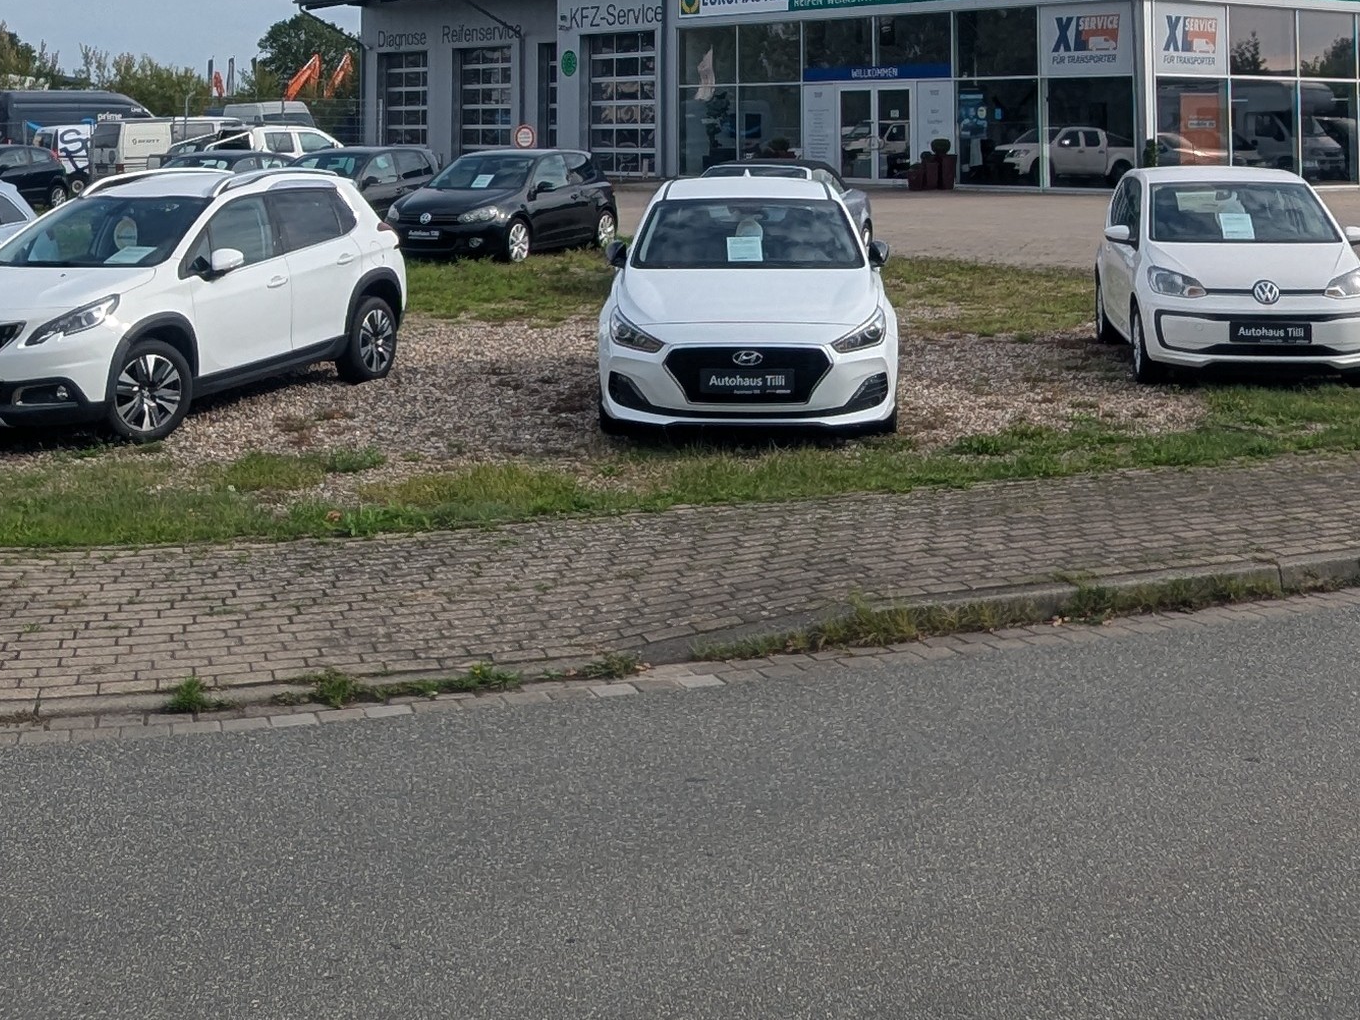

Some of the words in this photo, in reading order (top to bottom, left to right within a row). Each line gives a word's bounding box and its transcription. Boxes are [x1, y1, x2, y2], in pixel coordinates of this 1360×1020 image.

[569, 3, 664, 29] KFZ-Service
[1079, 15, 1119, 31] SERVICE
[1184, 17, 1217, 33] SERVICE
[377, 30, 428, 50] Diagnose
[441, 24, 523, 45] Reifenservice
[1176, 56, 1216, 67] TRANSPORTER
[851, 66, 899, 79] WILLKOMMEN
[1237, 326, 1285, 337] Autohaus
[1286, 327, 1304, 337] Tilli
[709, 374, 763, 387] Autohaus
[765, 374, 786, 387] Tilli
